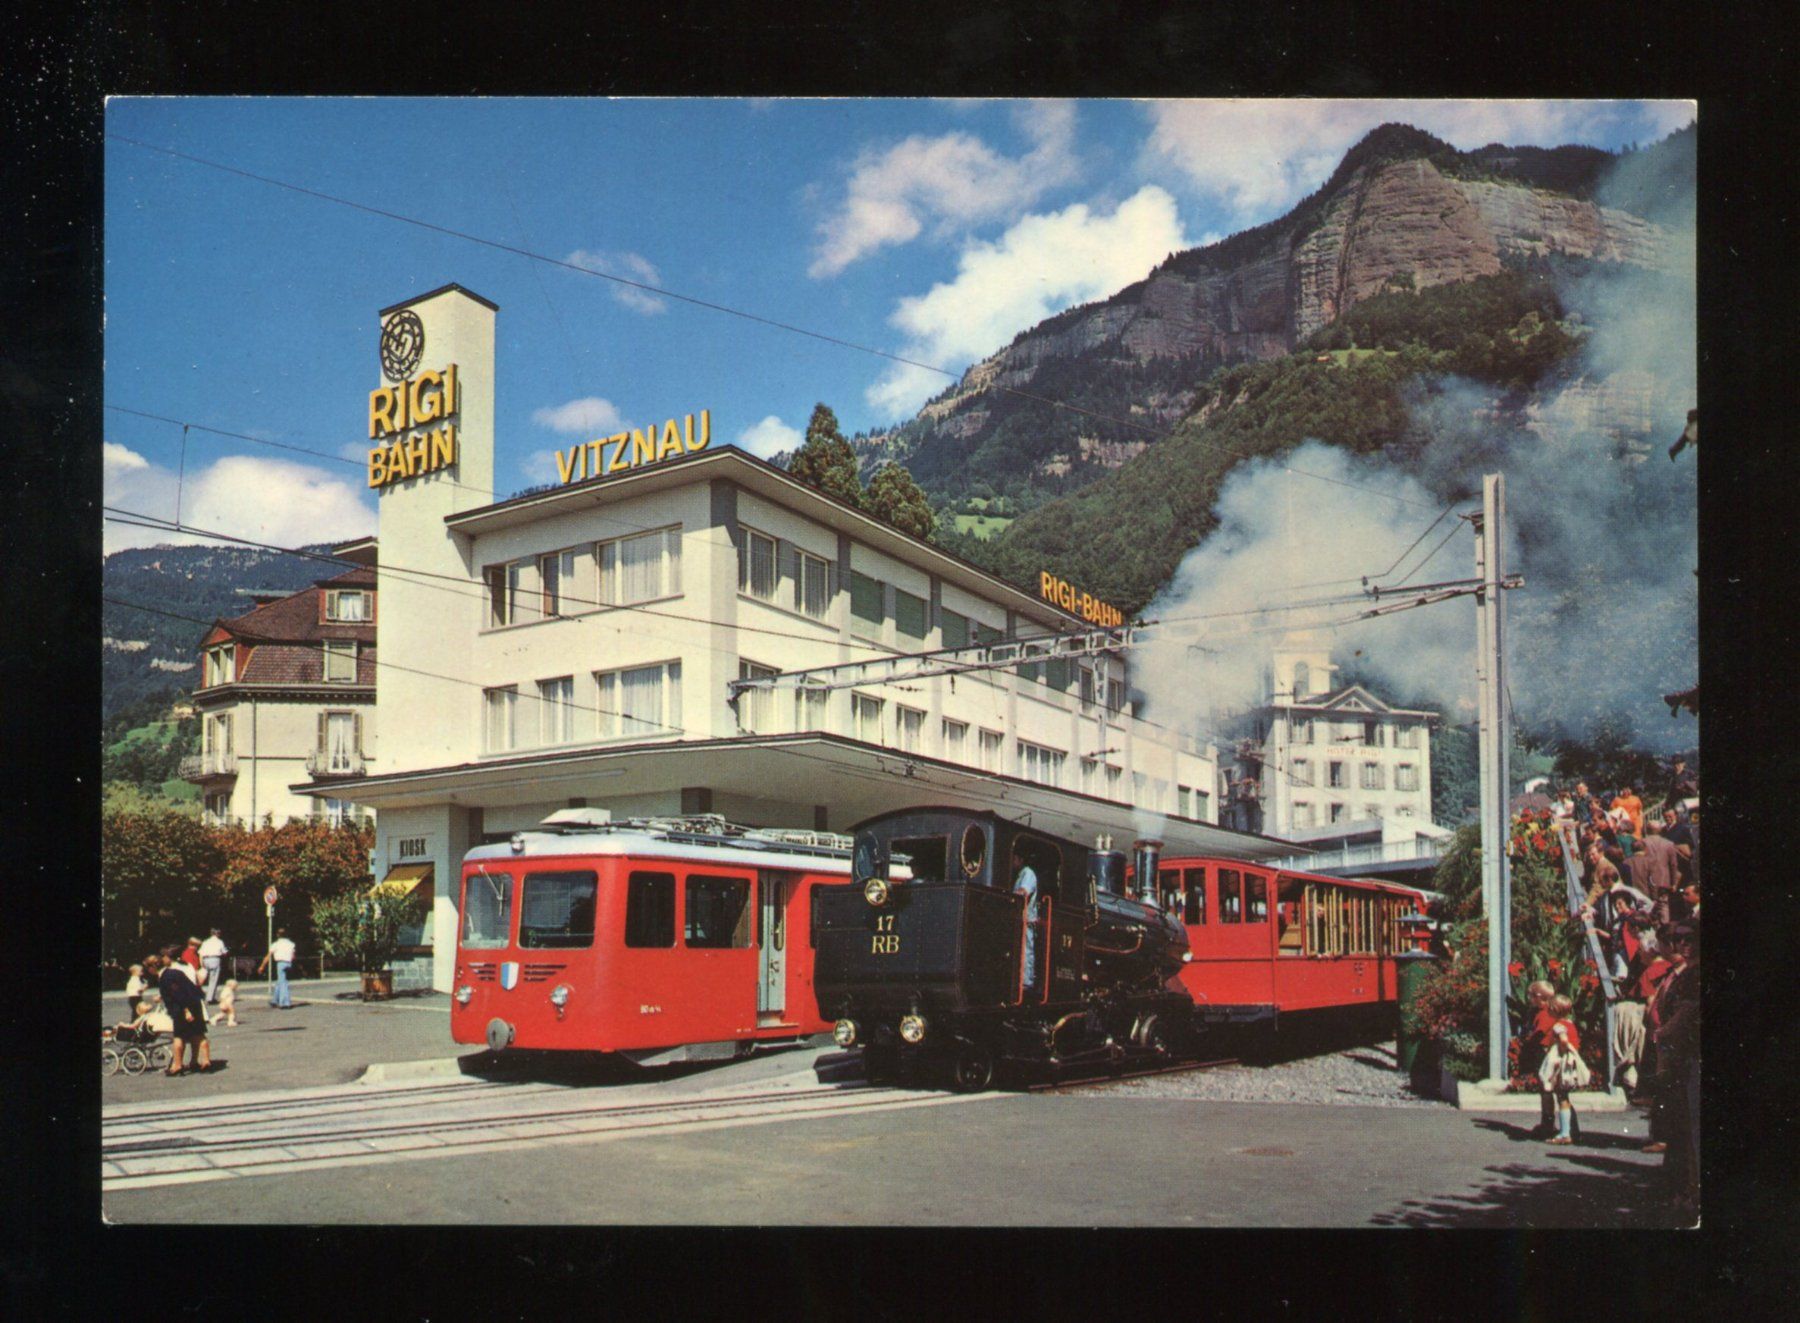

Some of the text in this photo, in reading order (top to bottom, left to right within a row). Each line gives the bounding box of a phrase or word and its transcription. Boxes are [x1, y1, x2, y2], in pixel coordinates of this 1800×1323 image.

[369, 364, 457, 439] RIGI
[368, 424, 456, 488] BAHN
[555, 409, 710, 484] VITZNAU
[1041, 571, 1122, 627] RIGI-BAHN
[400, 838, 427, 859] KIOSK
[877, 915, 895, 931] 17
[1062, 934, 1073, 948] 17
[872, 935, 900, 954] RB
